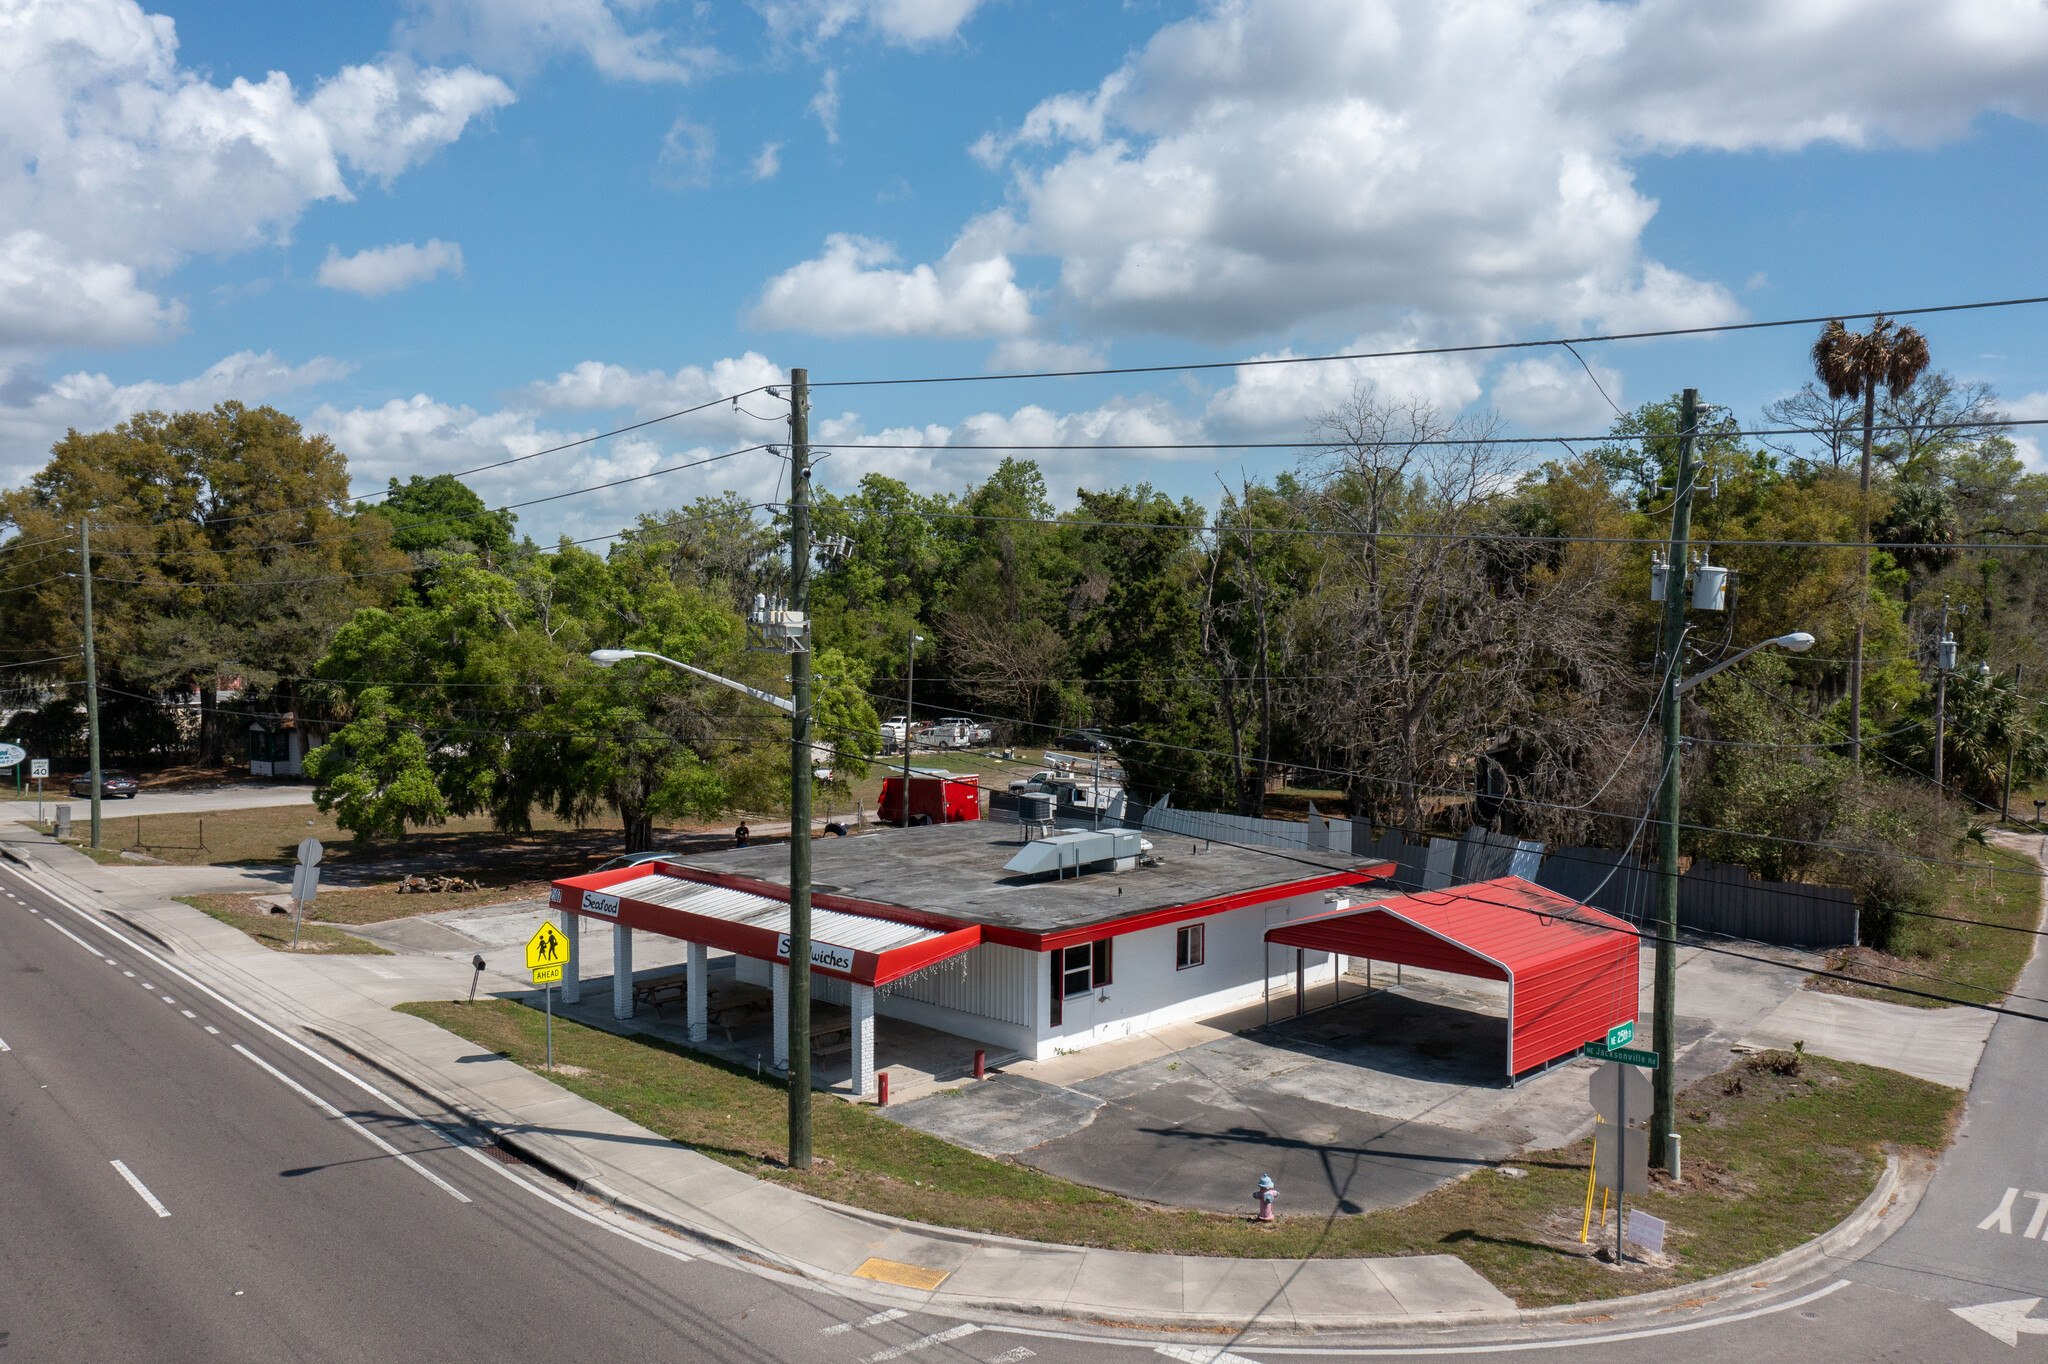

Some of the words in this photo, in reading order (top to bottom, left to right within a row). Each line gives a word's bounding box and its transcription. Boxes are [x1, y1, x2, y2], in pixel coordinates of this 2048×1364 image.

[583, 893, 619, 914] Seafood
[779, 938, 849, 969] Swiches
[537, 969, 560, 979] AHEAD
[1610, 1036, 1617, 1045] NE
[1595, 1048, 1646, 1063] Jacksonville
[1647, 1057, 1656, 1065] Rd
